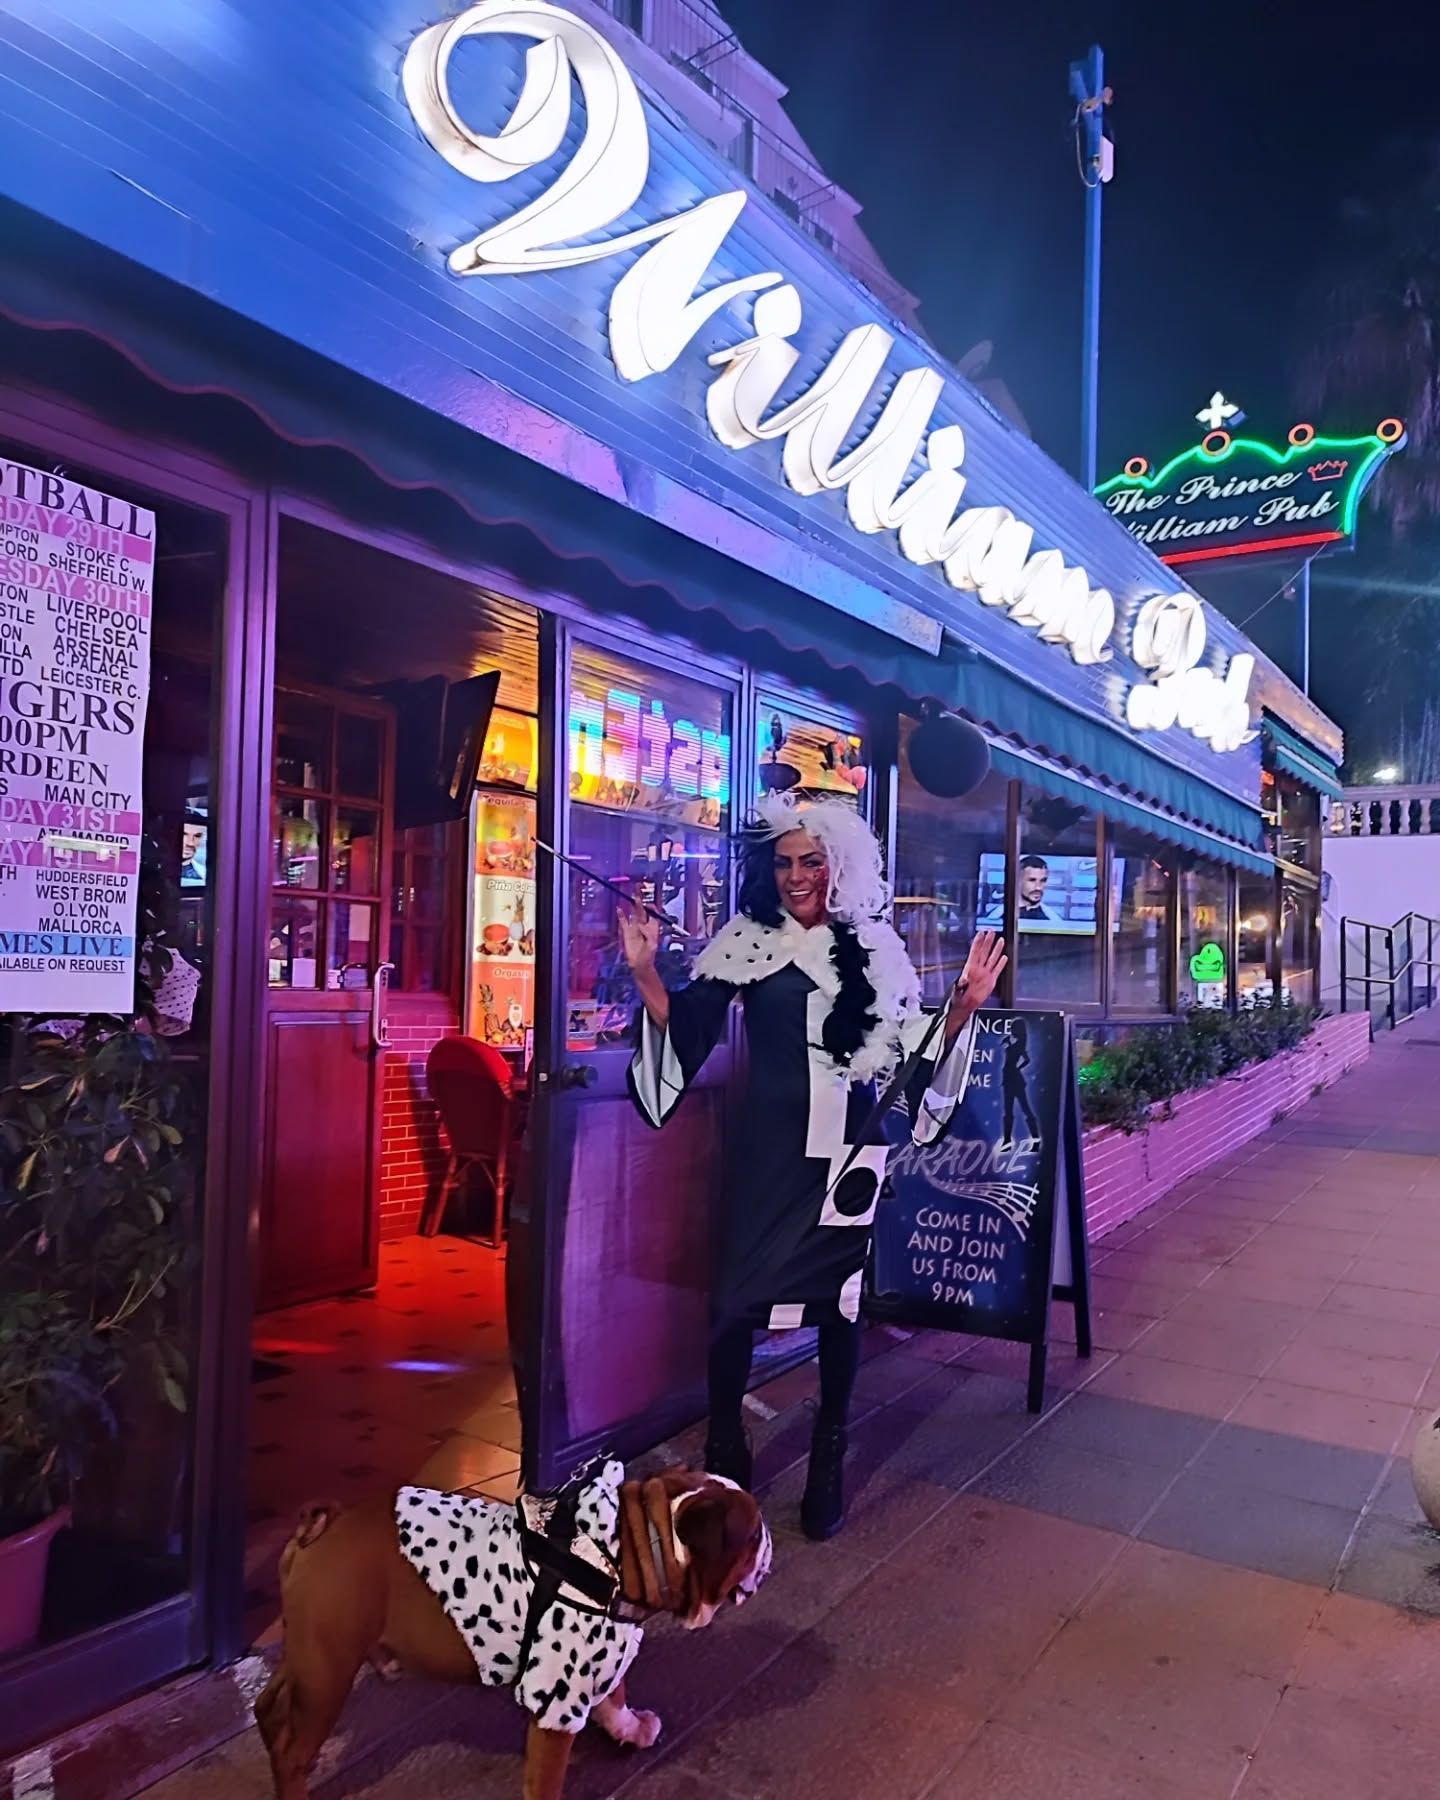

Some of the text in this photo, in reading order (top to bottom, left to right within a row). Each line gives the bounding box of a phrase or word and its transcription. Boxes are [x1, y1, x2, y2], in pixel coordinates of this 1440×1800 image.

[402, 0, 1114, 665] William
[0, 464, 152, 539] TBALL
[1106, 471, 1303, 516] The Prince
[1253, 491, 1340, 526] Pub
[65, 519, 124, 554] 29TH
[48, 552, 148, 593] SHEFFIELD W.
[65, 542, 133, 573] STOKE C.
[83, 580, 141, 616] 30TH
[47, 594, 147, 634] LIVERPOOL
[55, 616, 138, 650] CHELSEA
[53, 635, 138, 668] ARSENAL
[41, 666, 141, 699] LEICESTER C.
[44, 784, 131, 810] MAN CITY
[61, 805, 121, 833] 31ST
[36, 869, 128, 887] HUDDERSFIELD
[36, 884, 126, 904] WEST BROM
[53, 902, 109, 918] O.LYON
[38, 918, 122, 935] MALLORCA
[63, 935, 123, 956] LIVE
[48, 958, 66, 970] ON
[70, 959, 125, 972] REQUEST
[886, 1136, 1033, 1176] ARAOKE
[916, 1207, 1001, 1235] COME IN
[907, 1231, 1005, 1260] AND JOIN
[912, 1258, 997, 1284] US FROM
[931, 1283, 975, 1306] 9PM
